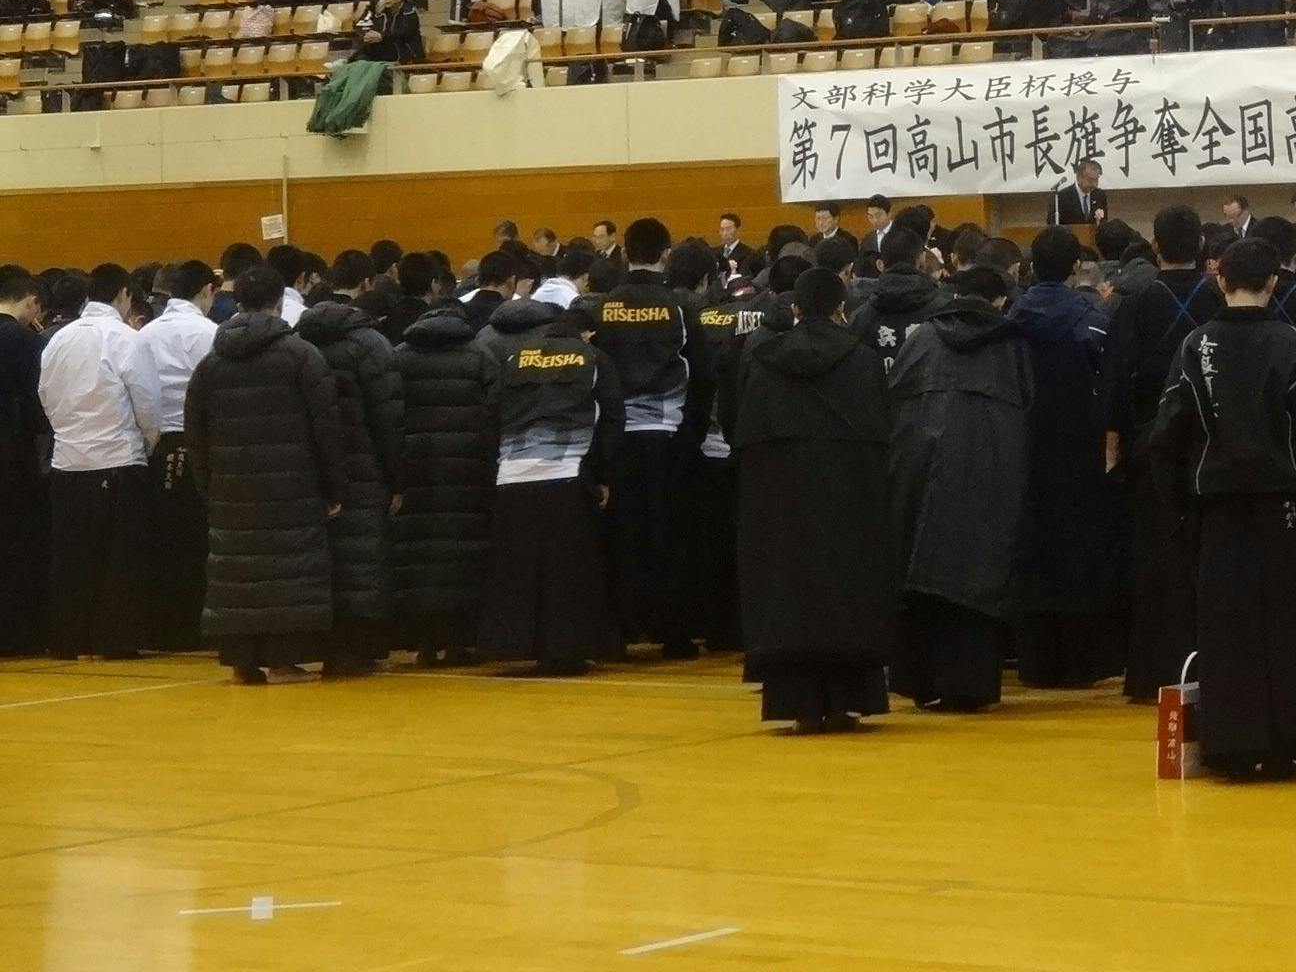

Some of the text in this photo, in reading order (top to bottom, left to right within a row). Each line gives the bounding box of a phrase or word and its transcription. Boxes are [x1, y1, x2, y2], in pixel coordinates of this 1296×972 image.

[790, 68, 1141, 111] 文部科学大臣杯授与
[602, 307, 670, 323] RISEISHA
[519, 354, 585, 369] RISEISHA
